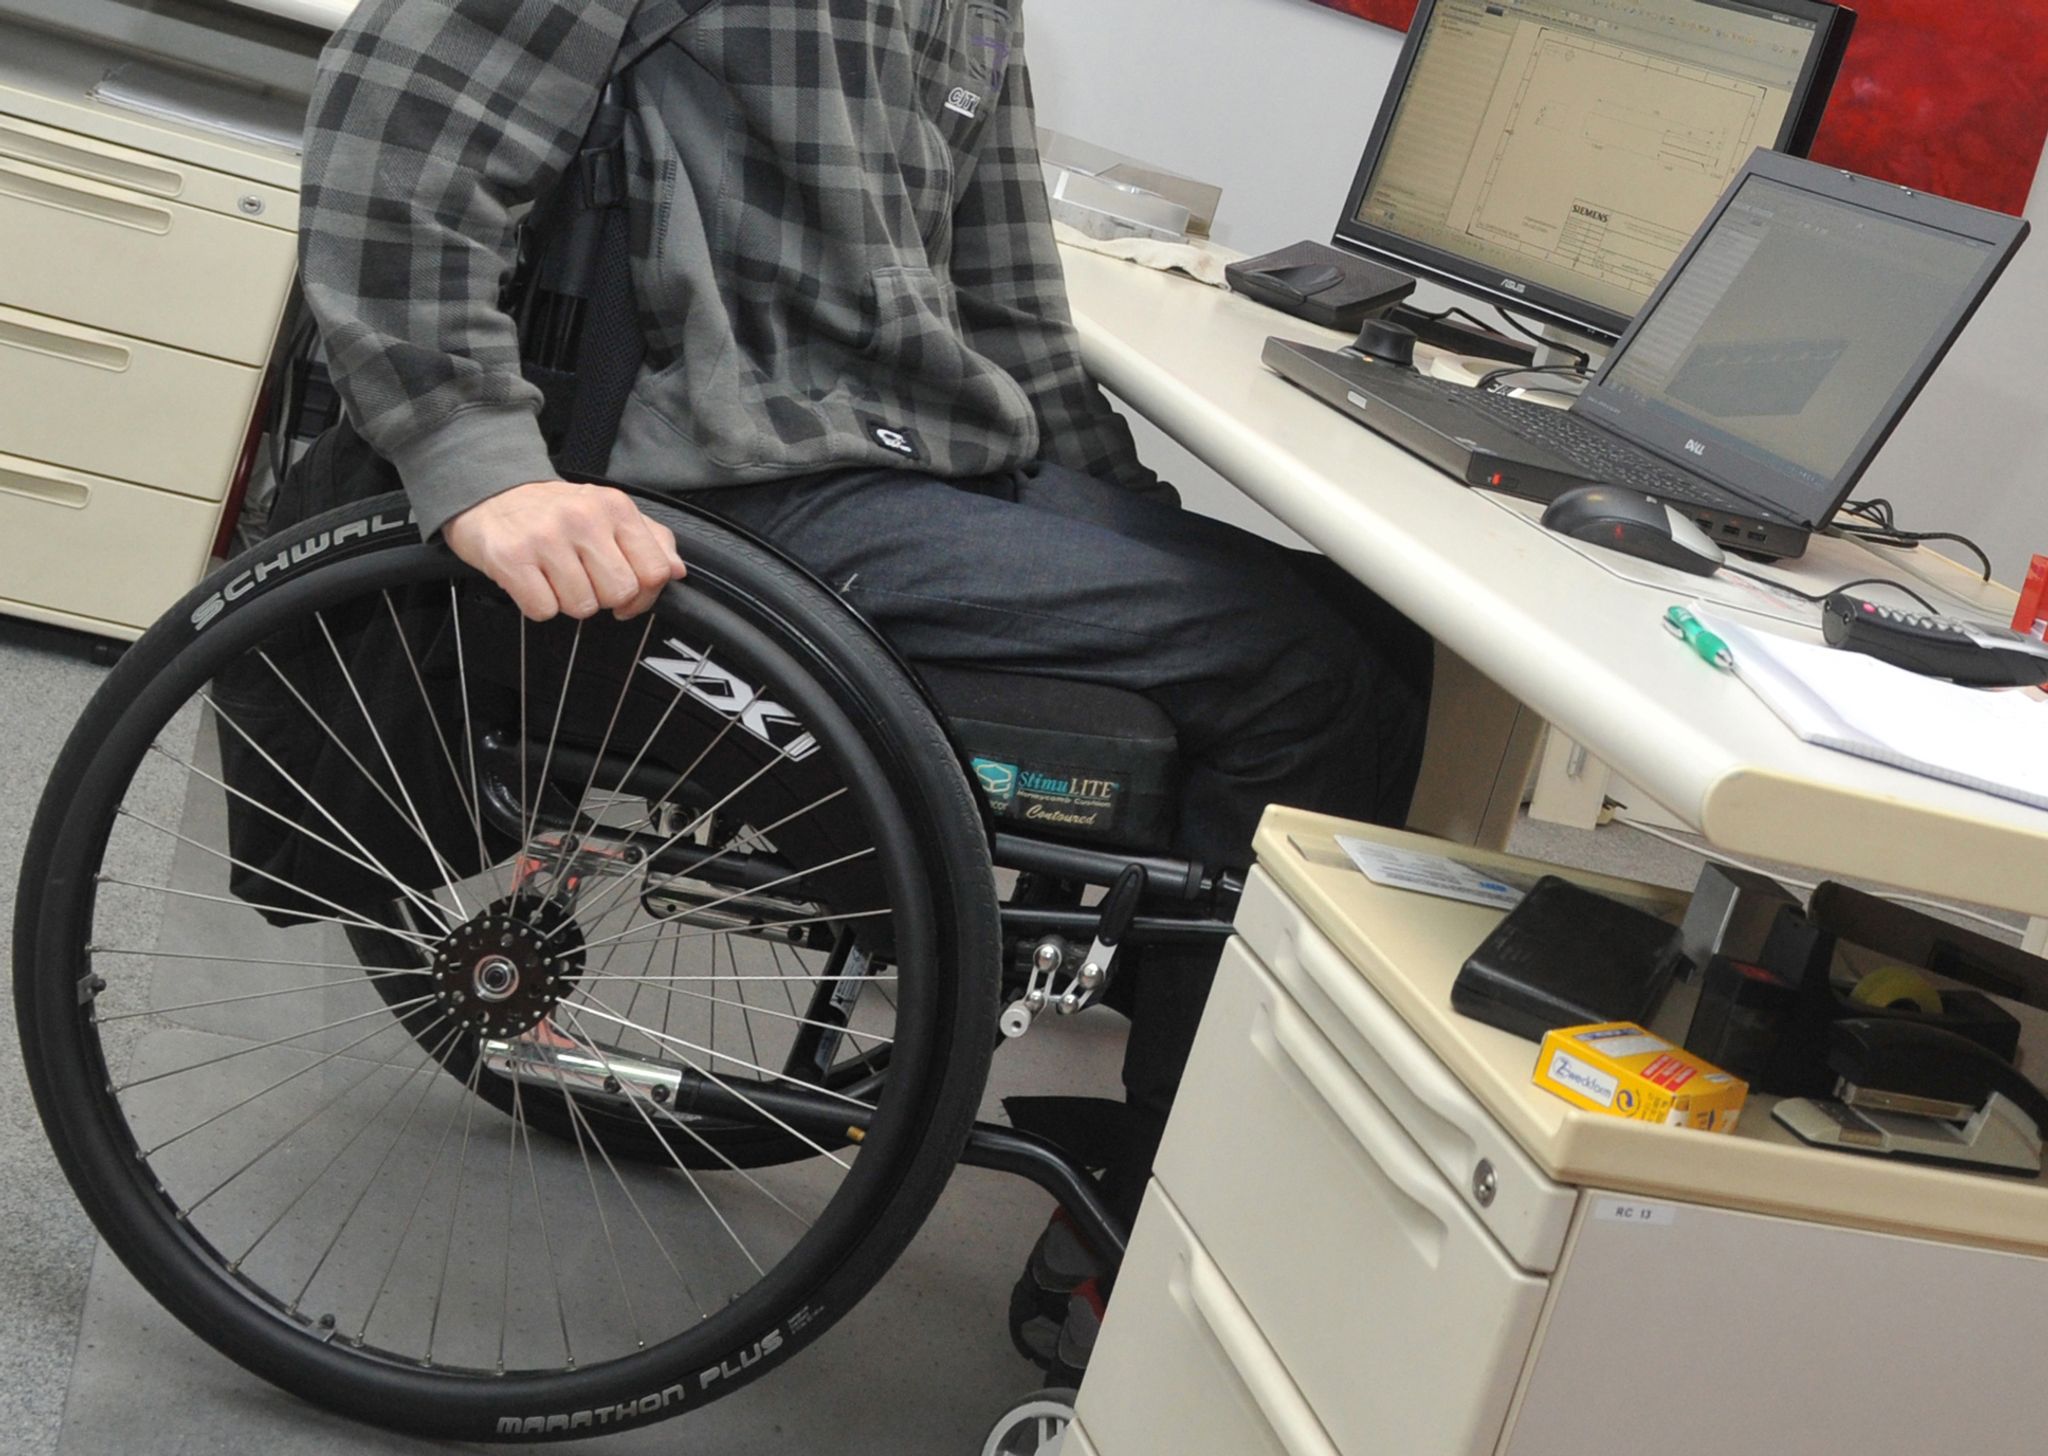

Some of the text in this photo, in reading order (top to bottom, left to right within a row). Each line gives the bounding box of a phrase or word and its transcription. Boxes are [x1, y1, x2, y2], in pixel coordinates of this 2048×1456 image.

[1572, 204, 1609, 223] SIEMENS
[1500, 278, 1526, 294] ASUS
[1684, 438, 1706, 456] DELL
[1025, 803, 1098, 825] Contoured
[1615, 1206, 1634, 1218] RC
[496, 1328, 784, 1434] MARATHON PLUS
